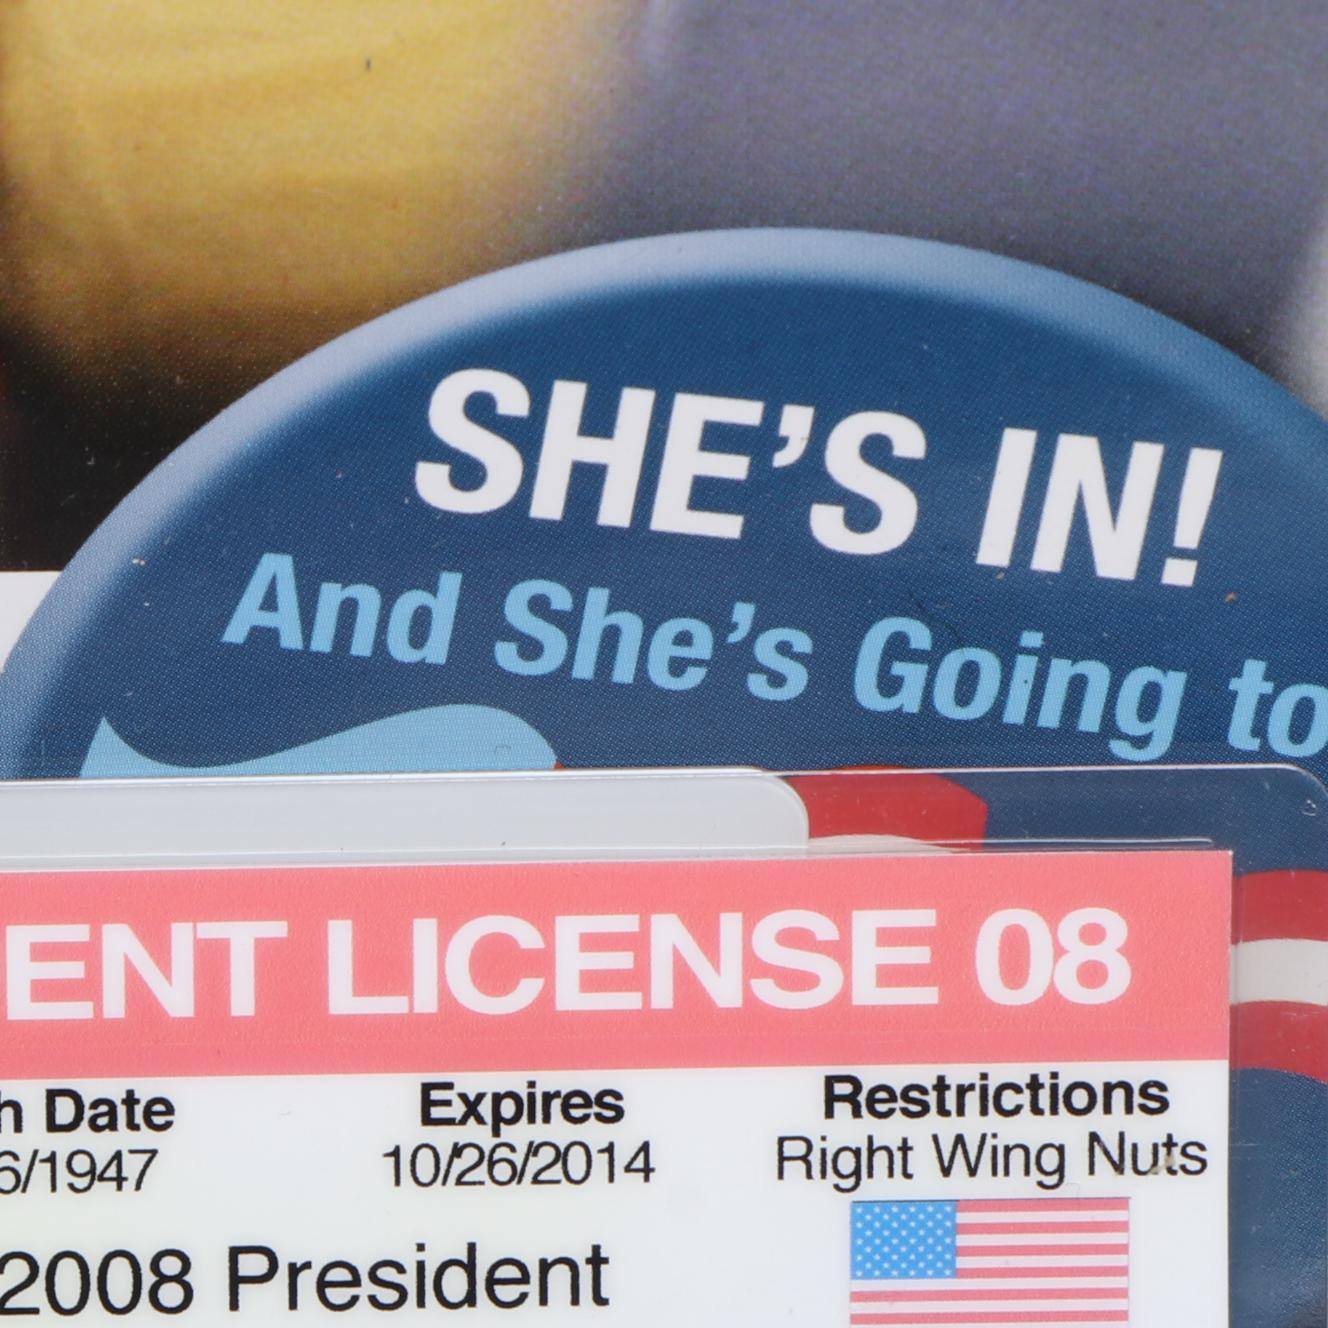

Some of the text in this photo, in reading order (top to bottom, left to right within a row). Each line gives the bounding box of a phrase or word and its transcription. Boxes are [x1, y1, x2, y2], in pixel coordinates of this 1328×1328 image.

[414, 368, 1224, 588] SHE'S IN!
[222, 553, 1328, 760] And She's Going to
[327, 909, 939, 1015] LICENSE
[975, 907, 1132, 1006] 08
[45, 1088, 175, 1134] Date
[419, 1081, 625, 1138] Expires
[824, 1071, 1170, 1119] Restrictions
[382, 1140, 656, 1188] 10/26/2014
[776, 1131, 1208, 1193] Right Wing Nuts
[228, 1242, 610, 1311] President
